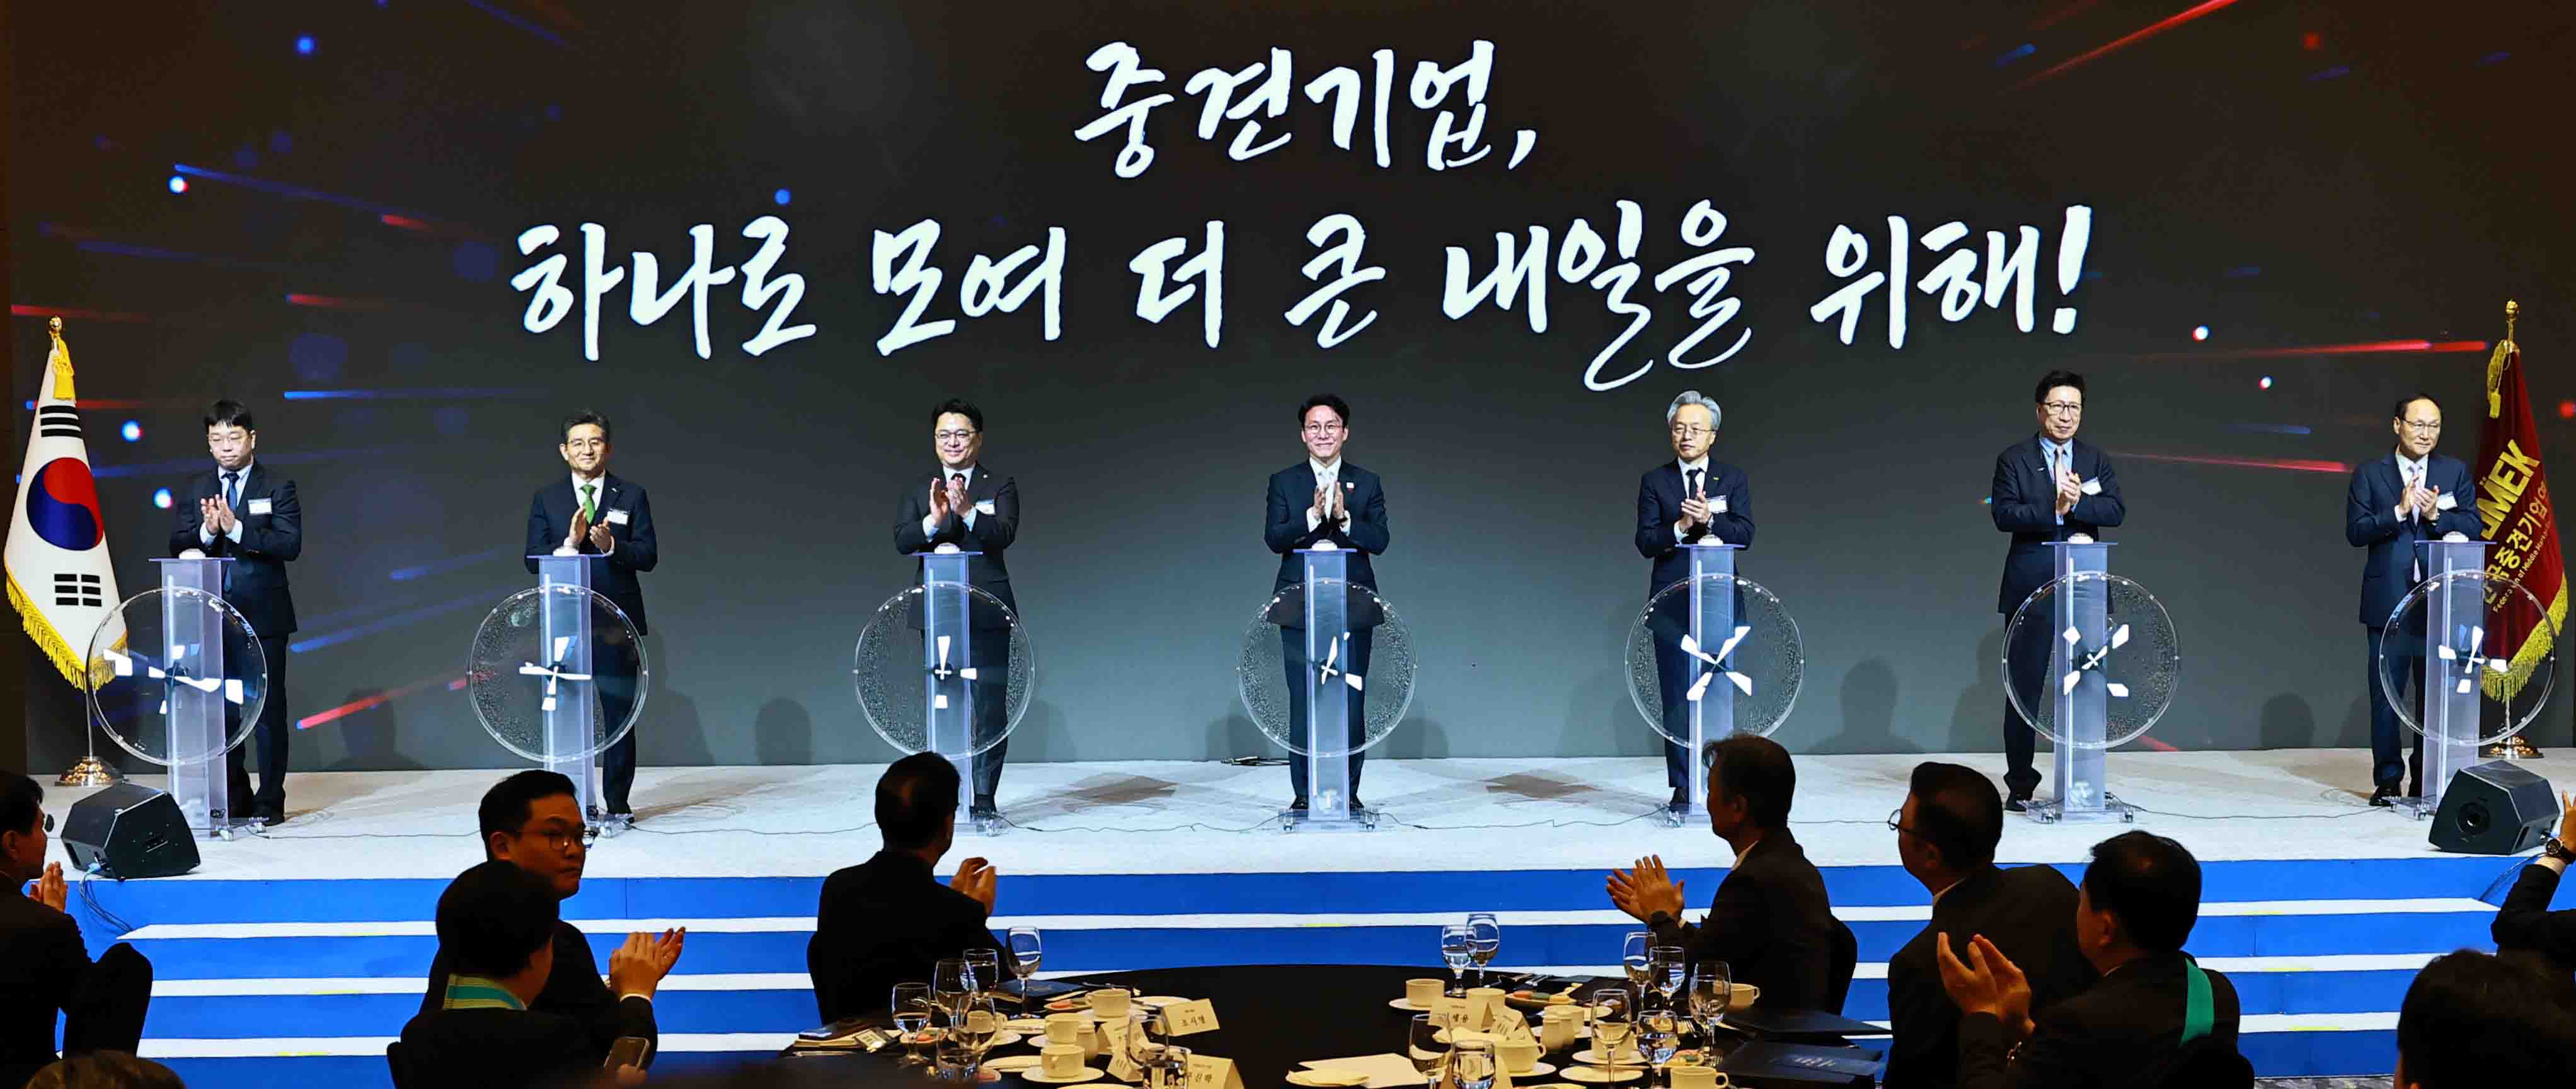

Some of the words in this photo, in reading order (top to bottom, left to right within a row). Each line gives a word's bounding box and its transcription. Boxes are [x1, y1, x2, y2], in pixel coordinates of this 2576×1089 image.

[1074, 40, 1536, 178] 중견기업,
[511, 216, 817, 361] 하나로
[873, 219, 1066, 356] 모여
[1129, 220, 1224, 348] 더
[1284, 214, 1386, 349] 큰
[1443, 199, 1755, 391] 내일을
[1810, 205, 2091, 349] 위해!
[2522, 550, 2539, 572] Middle
